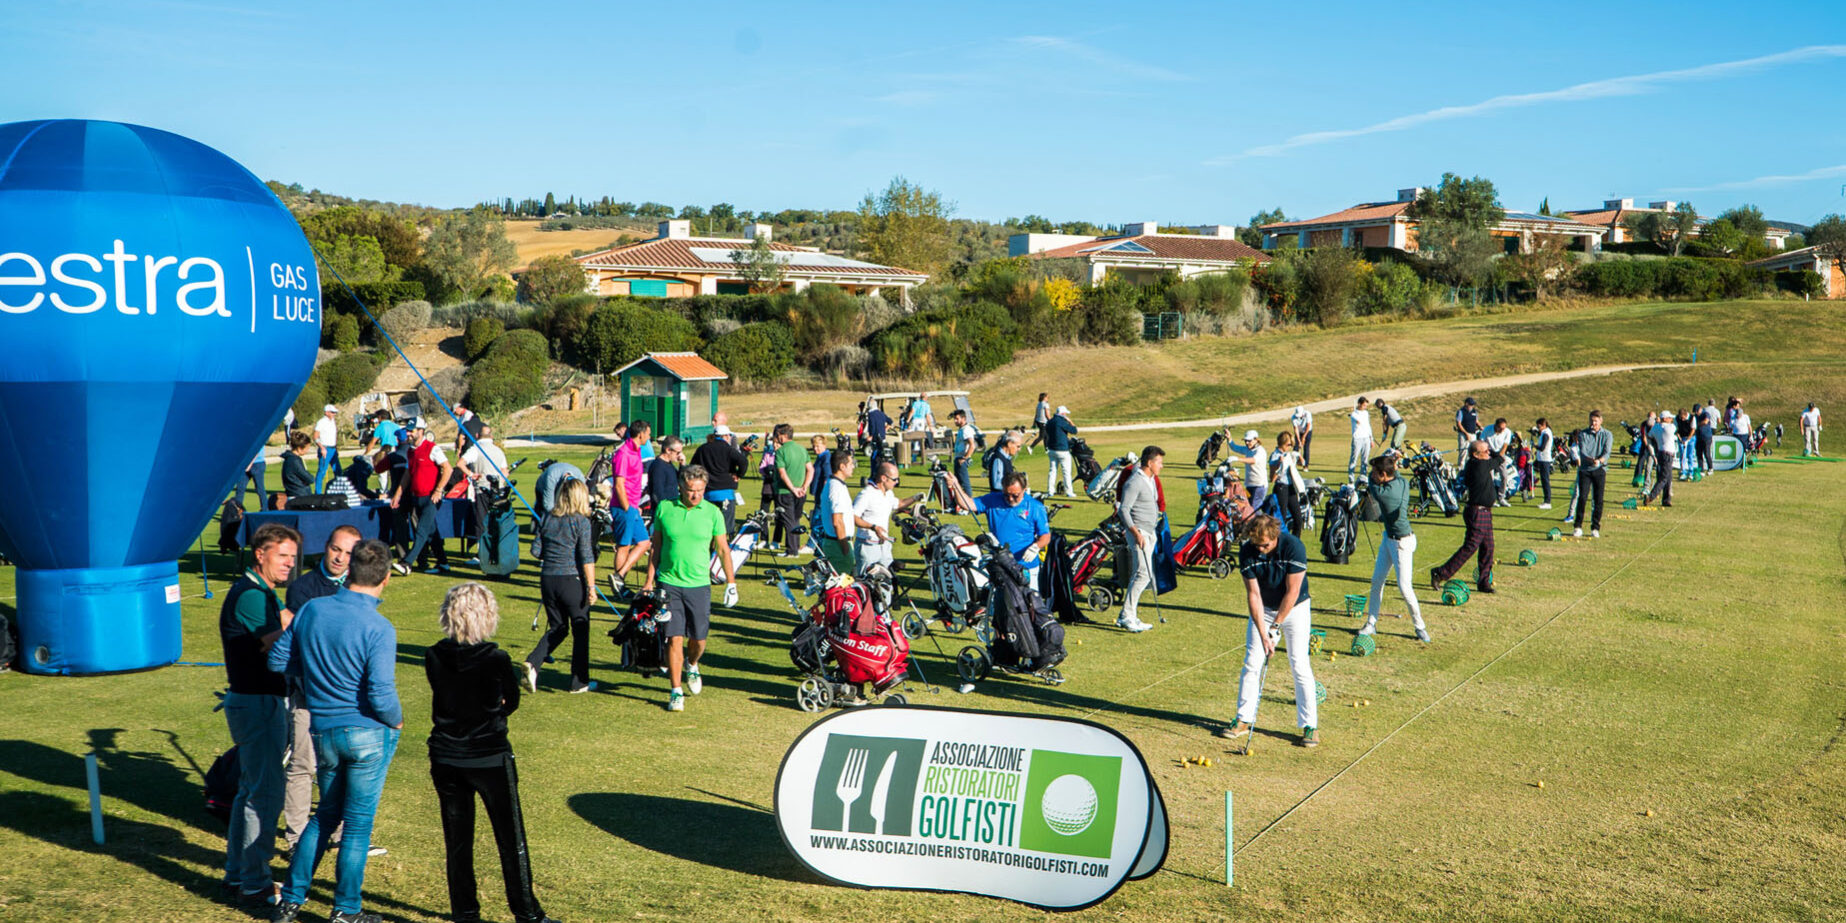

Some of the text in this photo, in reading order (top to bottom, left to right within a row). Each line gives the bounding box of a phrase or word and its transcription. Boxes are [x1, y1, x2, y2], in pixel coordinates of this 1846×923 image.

[0, 239, 232, 317] estra
[270, 263, 307, 291] GAS
[273, 294, 314, 323] LUCE
[857, 639, 889, 657] Staff
[930, 741, 1026, 772] ASSOCIAZIONE
[923, 766, 1021, 801] RISTORATORI
[919, 795, 1016, 847] GOLFISTI
[810, 835, 1110, 878] WWW.ASSOCIAZIONERISTORATORIGOLFISTI.COM
